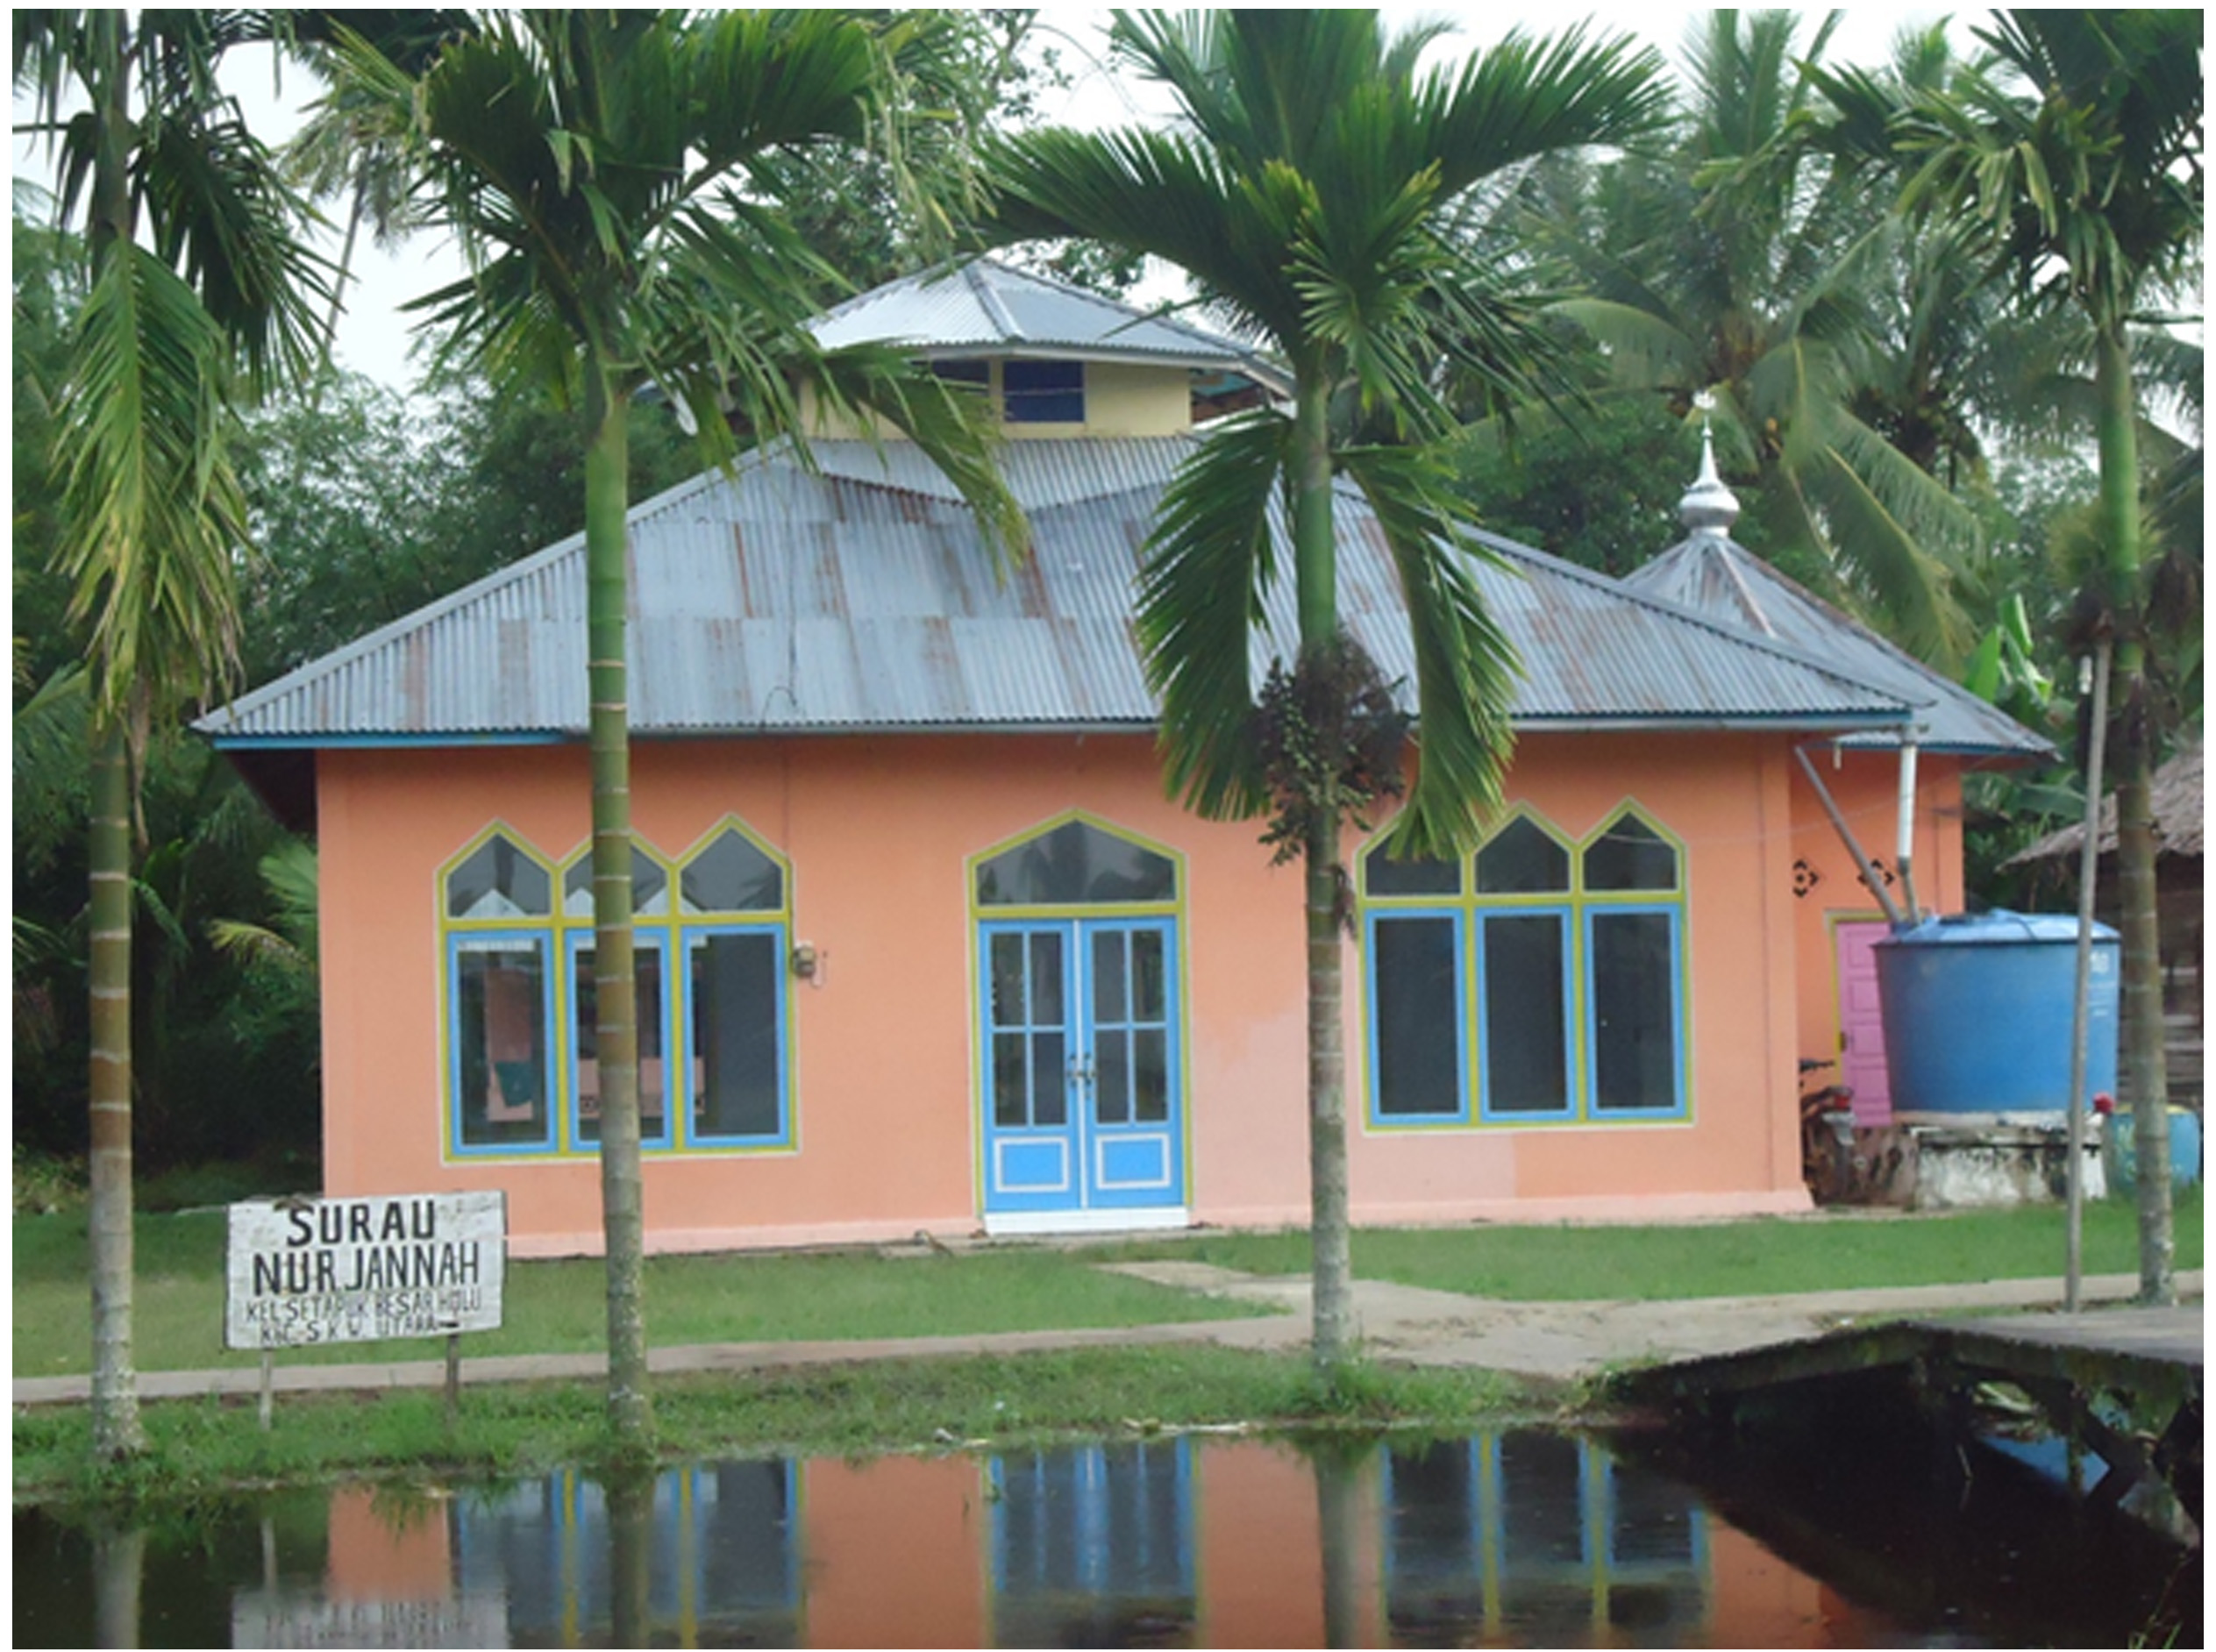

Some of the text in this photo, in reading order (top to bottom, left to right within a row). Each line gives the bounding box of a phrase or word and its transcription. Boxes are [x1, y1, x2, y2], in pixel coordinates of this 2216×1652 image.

[287, 1200, 435, 1247] SURAU
[253, 1242, 479, 1296] NUR JANNAH
